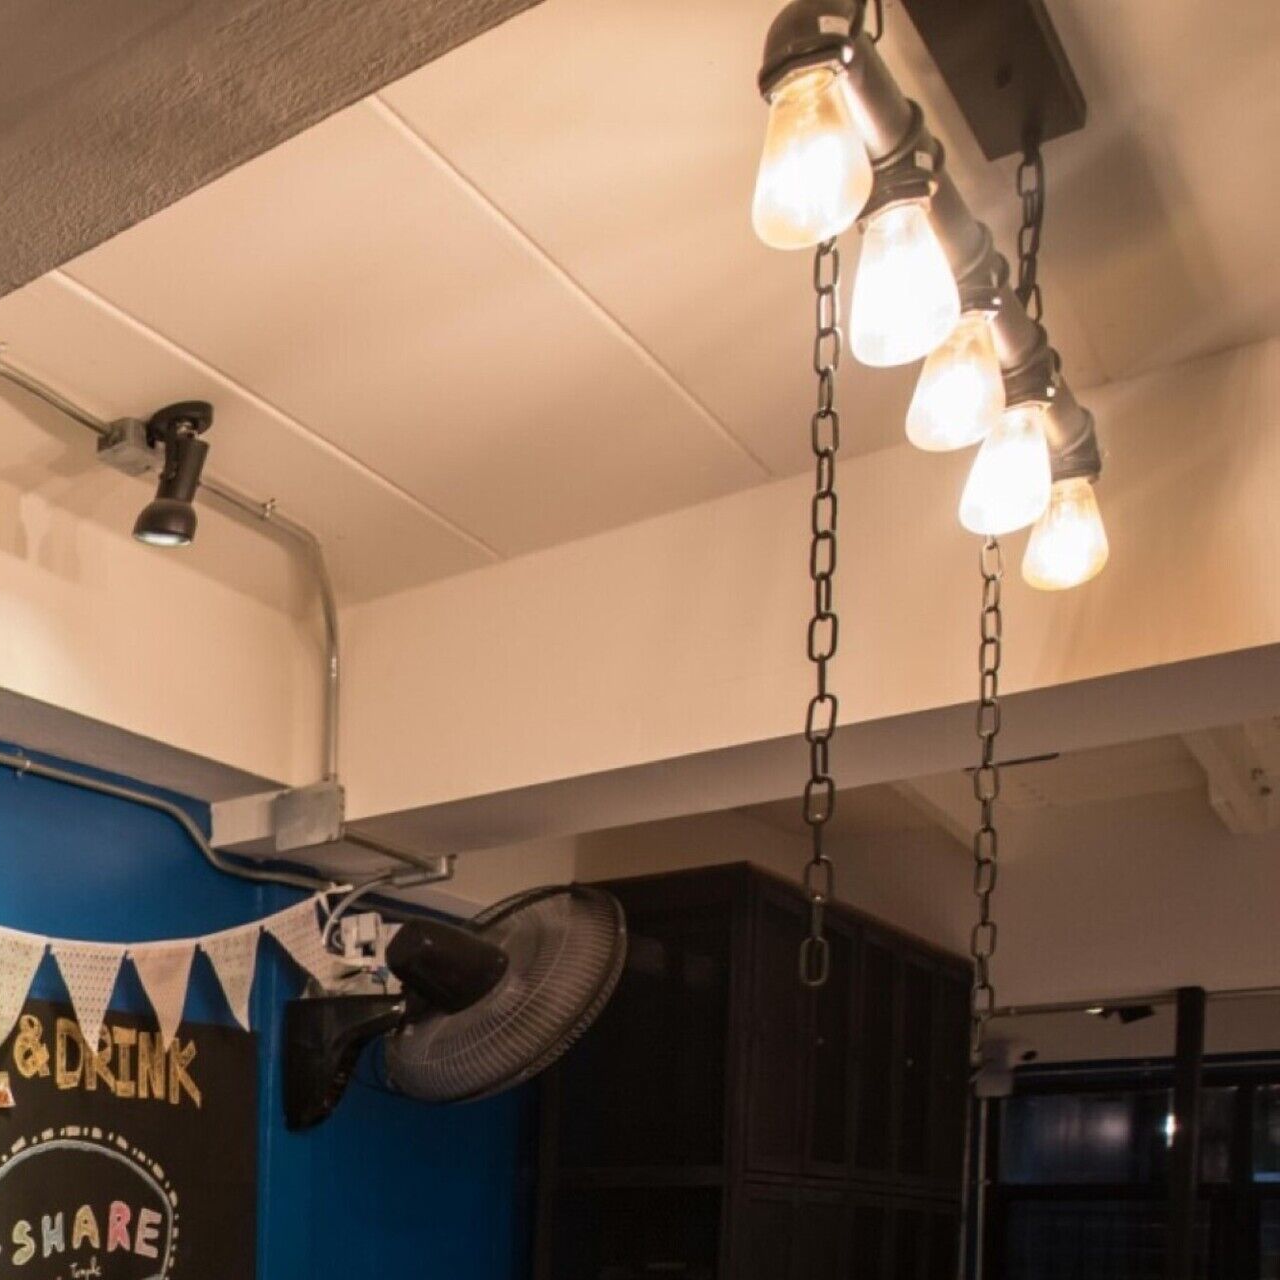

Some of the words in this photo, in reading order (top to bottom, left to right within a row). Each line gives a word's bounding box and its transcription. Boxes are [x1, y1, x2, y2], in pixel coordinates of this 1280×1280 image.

[13, 1014, 50, 1078] &
[56, 1016, 203, 1110] DRINK
[11, 1200, 163, 1266] SHARE
